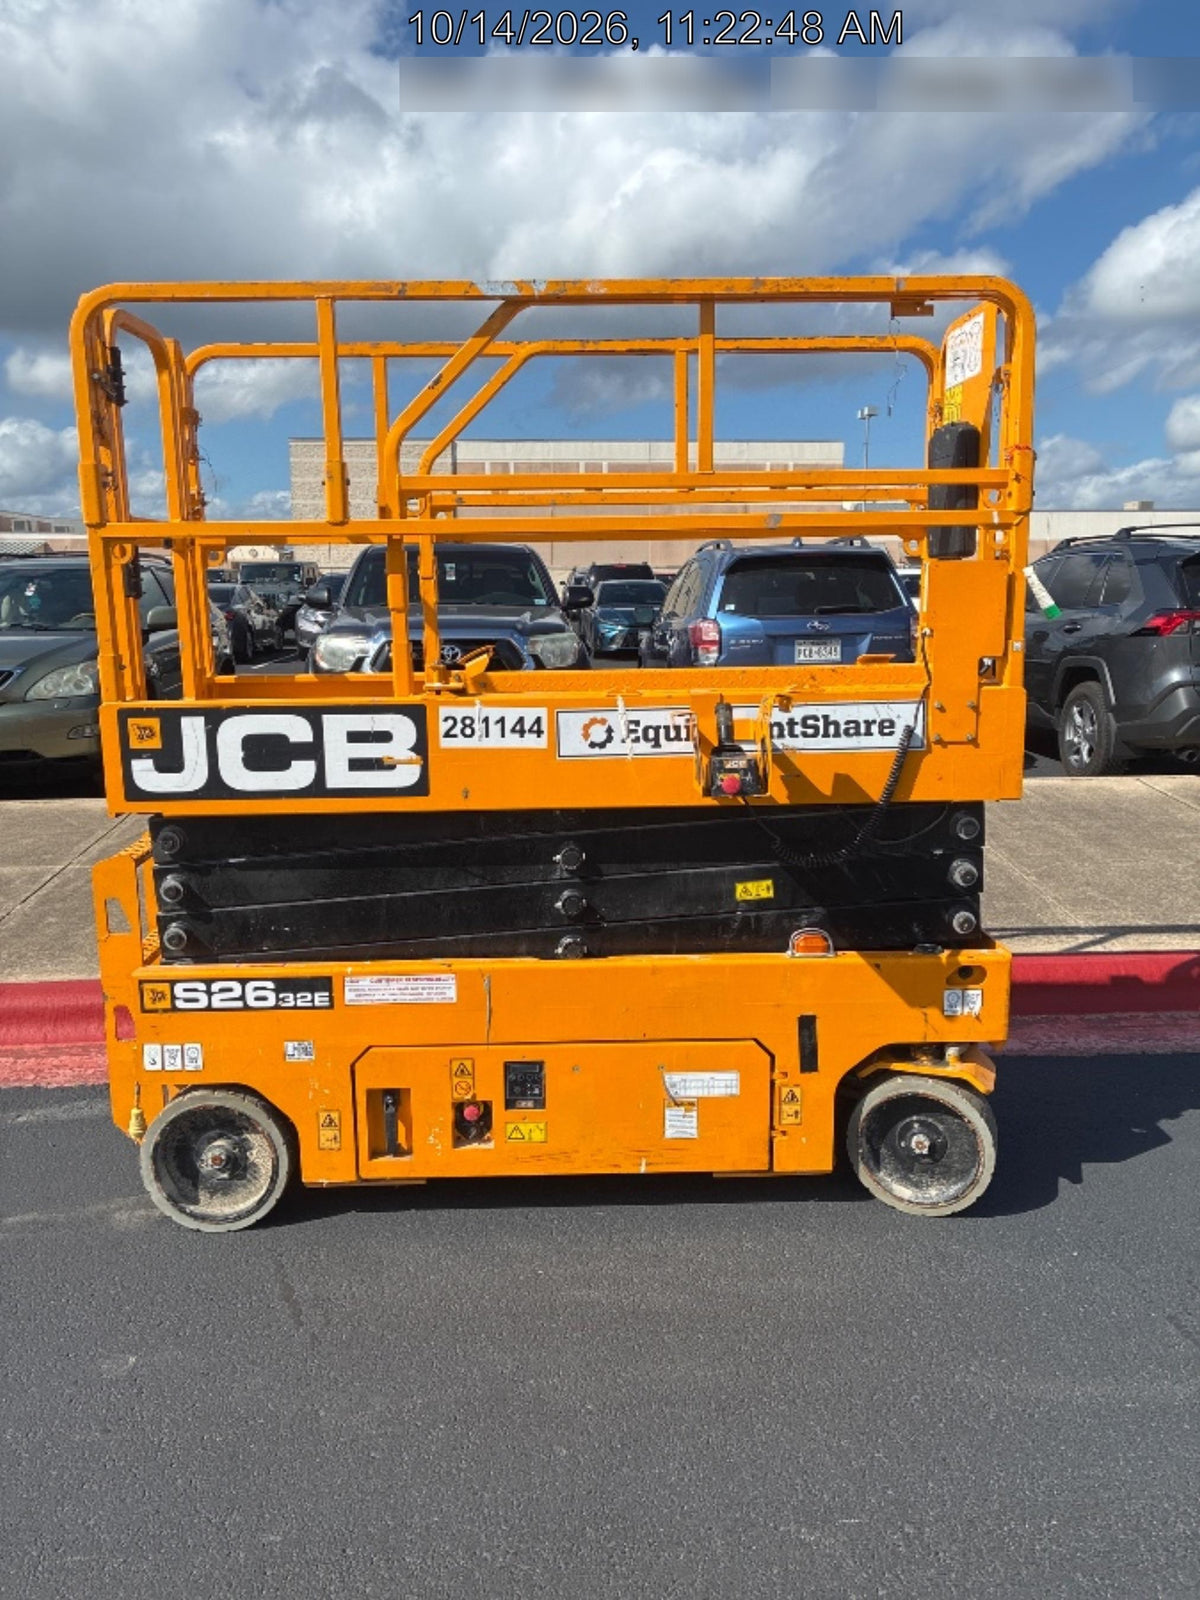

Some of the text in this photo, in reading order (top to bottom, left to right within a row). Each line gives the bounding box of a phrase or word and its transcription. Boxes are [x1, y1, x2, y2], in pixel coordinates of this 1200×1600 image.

[442, 716, 545, 739] 281144
[621, 713, 897, 749] EquintShare
[131, 713, 423, 793] JCB
